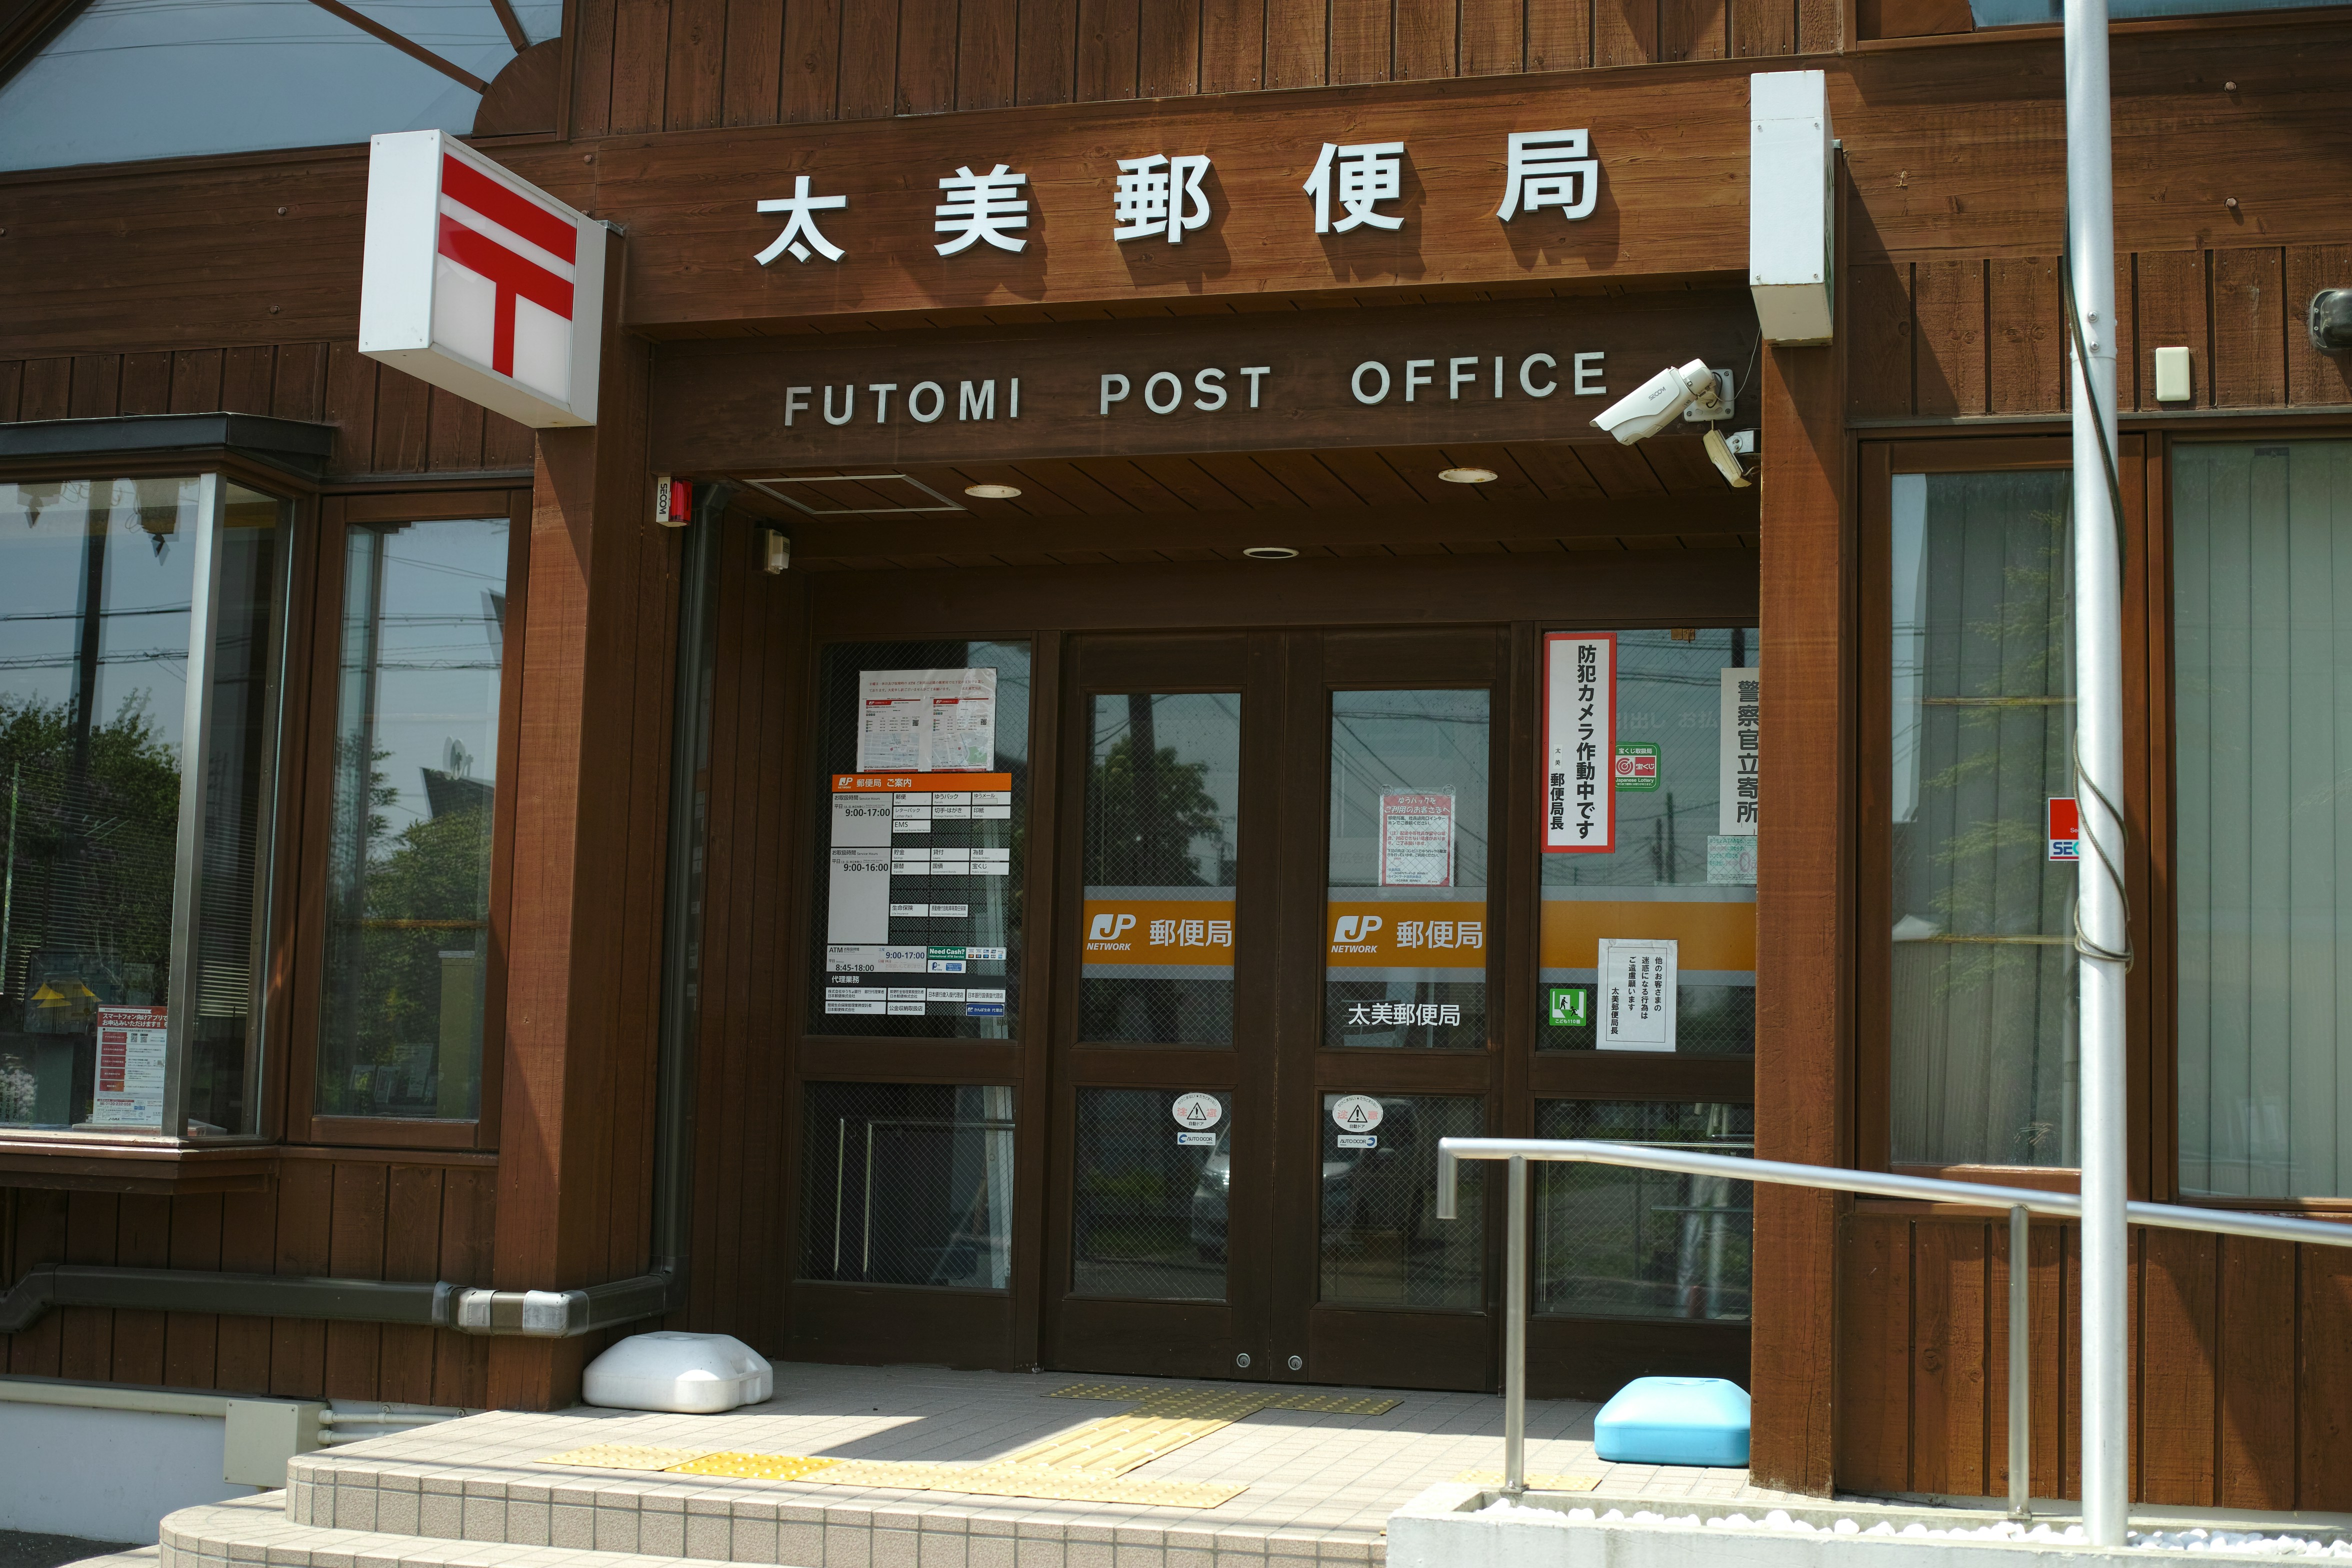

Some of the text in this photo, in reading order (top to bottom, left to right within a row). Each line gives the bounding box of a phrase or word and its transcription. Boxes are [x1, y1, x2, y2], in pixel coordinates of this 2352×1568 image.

[752, 128, 1601, 266] 太美郵便局
[784, 350, 1610, 428] FUTOMI POST OFFICE
[1648, 386, 1666, 401] SECOM
[659, 483, 668, 514] SECOM
[1576, 644, 1597, 840] 防犯カメラ作動中です
[1736, 680, 1759, 824] 警察官立寄所
[856, 778, 912, 788] 郵便局 ご案内
[845, 808, 890, 816] 9:00-17:00
[1384, 806, 1450, 814] ご利用のお客さまへ
[1550, 772, 1565, 831] 郵便局長
[844, 863, 888, 872] 9:00-16:00
[1088, 914, 1137, 940] JP
[1148, 919, 1232, 948] 郵便局
[1332, 916, 1383, 942] JP
[1396, 920, 1483, 949] 郵便局
[1086, 942, 1132, 951] NETWORK
[1330, 944, 1378, 954] NETWORK
[832, 976, 860, 984] 代理業務
[1628, 956, 1636, 1011] ご遠慮願います
[1640, 956, 1650, 1020] 迷惑になる行為は
[1654, 956, 1663, 1012] 他のお客さまの
[1348, 1003, 1461, 1027] 太美郵便局
[1610, 987, 1620, 1035] 太美郵便局長
[1178, 1094, 1217, 1106] かけこまない たちどまらない
[1338, 1096, 1378, 1108] かけこまない たちどまらない
